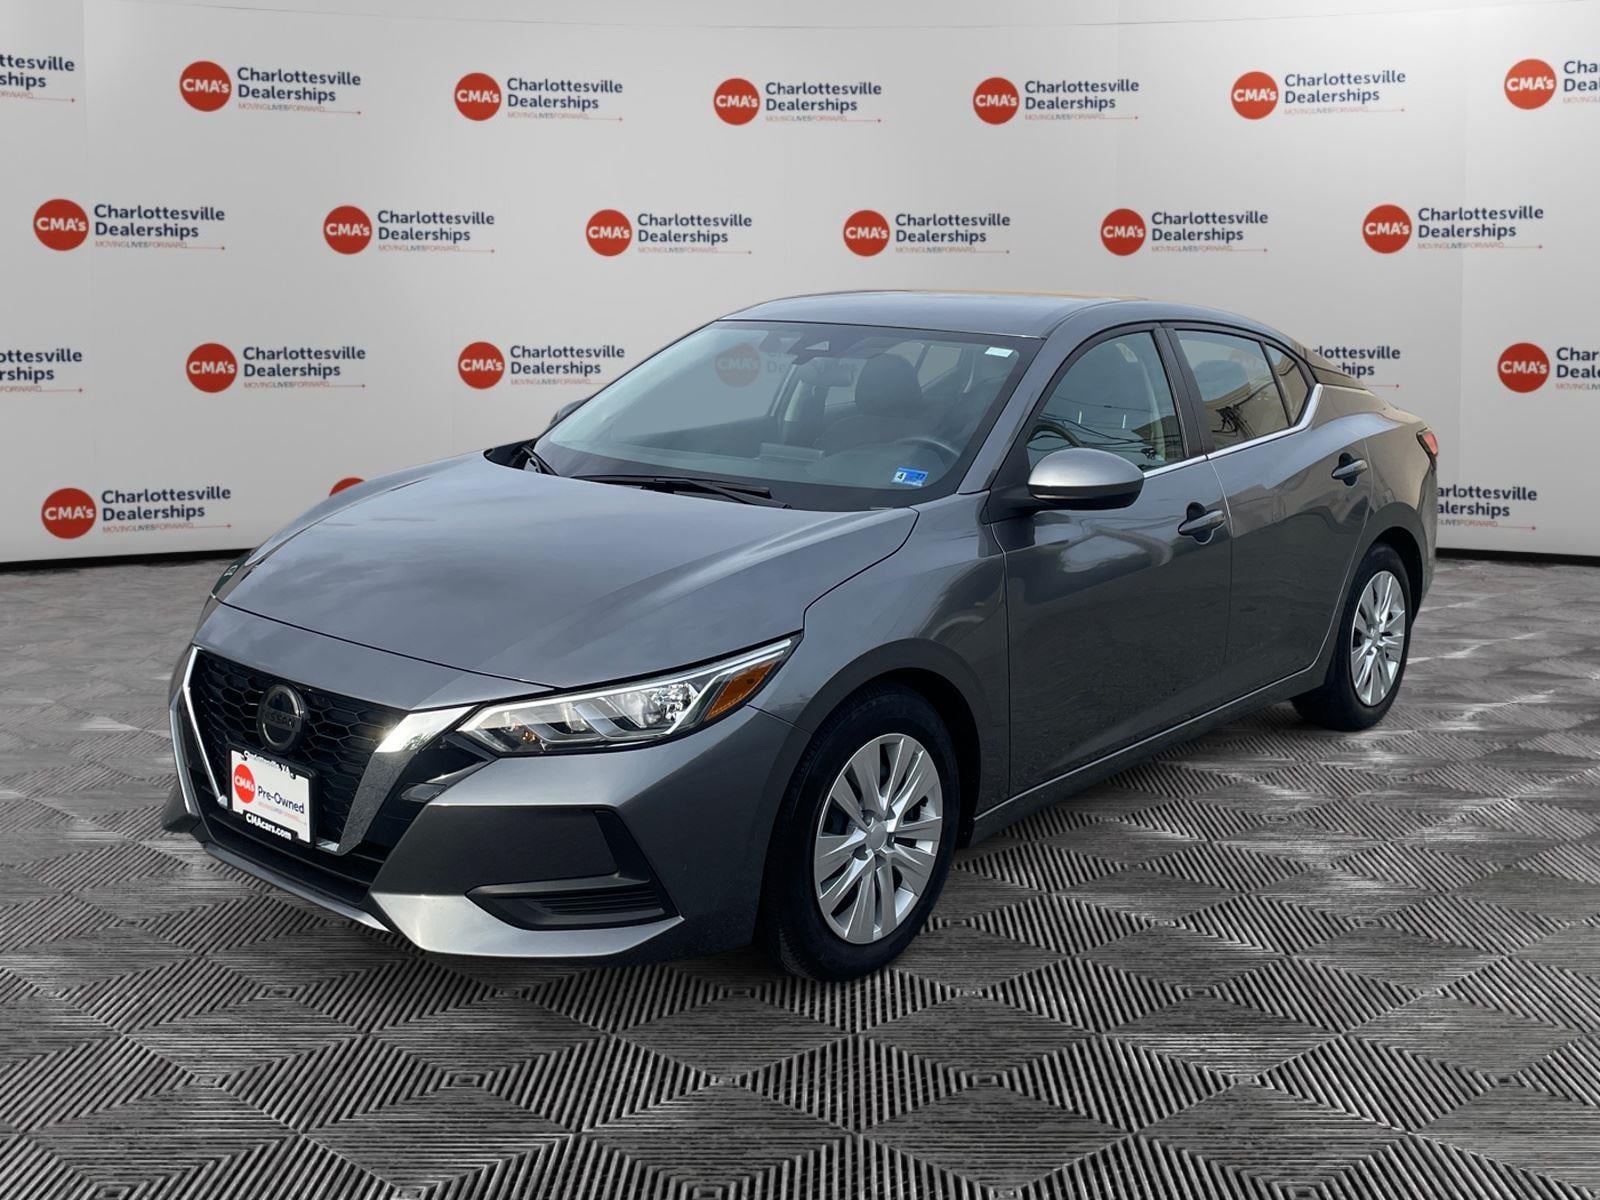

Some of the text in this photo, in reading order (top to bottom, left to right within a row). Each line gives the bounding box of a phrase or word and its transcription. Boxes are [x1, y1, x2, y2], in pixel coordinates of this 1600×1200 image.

[1563, 60, 1600, 74] Cha
[236, 66, 361, 86] Charlottesville
[1284, 70, 1405, 87] Charlottesville
[1506, 75, 1554, 92] CMA's
[182, 78, 230, 94] CMA's
[237, 83, 336, 103] Dealerships
[506, 79, 623, 93] Charlottesville
[765, 81, 881, 95] Charlottesville
[1024, 79, 1140, 94] Charlottesville
[457, 89, 499, 104] CMA's
[507, 93, 599, 110] Dealerships
[715, 94, 758, 109] CMA's
[975, 93, 1016, 108] CMA's
[1234, 87, 1276, 103] CMA's
[1285, 90, 1380, 104] Dealerships
[765, 98, 857, 113] Dealerships
[1025, 96, 1116, 112] Dealerships
[93, 203, 225, 221] Charlottesville
[377, 210, 495, 225] Charlottesville
[1151, 210, 1268, 226] Charlottesville
[1417, 206, 1544, 222] Charlottesville
[35, 216, 87, 232] CMA's
[637, 213, 753, 227] Charlottesville
[895, 214, 1010, 228] Charlottesville
[94, 221, 199, 239] Dealerships
[325, 222, 370, 237] CMA's
[378, 226, 471, 243] Dealerships
[587, 225, 630, 240] CMA's
[638, 229, 728, 244] Dealerships
[846, 226, 888, 240] CMA's
[1102, 224, 1143, 239] CMA's
[1151, 227, 1244, 243] Dealerships
[1363, 221, 1411, 237] CMA's
[1418, 224, 1516, 239] Dealerships
[895, 229, 986, 245] Dealerships
[242, 346, 367, 360] Charlottesville
[509, 346, 625, 359] Charlottesville
[1313, 346, 1401, 360] lottesville
[188, 360, 236, 375] CMA's
[244, 365, 340, 379] Dealerships
[460, 358, 502, 372] CMA's
[510, 361, 601, 375] Dealerships
[1337, 362, 1375, 379] hips
[1500, 360, 1548, 375] CMA's
[101, 487, 231, 505] Charlottesville
[43, 505, 93, 521] CMA's
[101, 506, 205, 522] Dealerships
[257, 785, 305, 814] Pre-Owned
[245, 813, 292, 841] CMAcars.com
